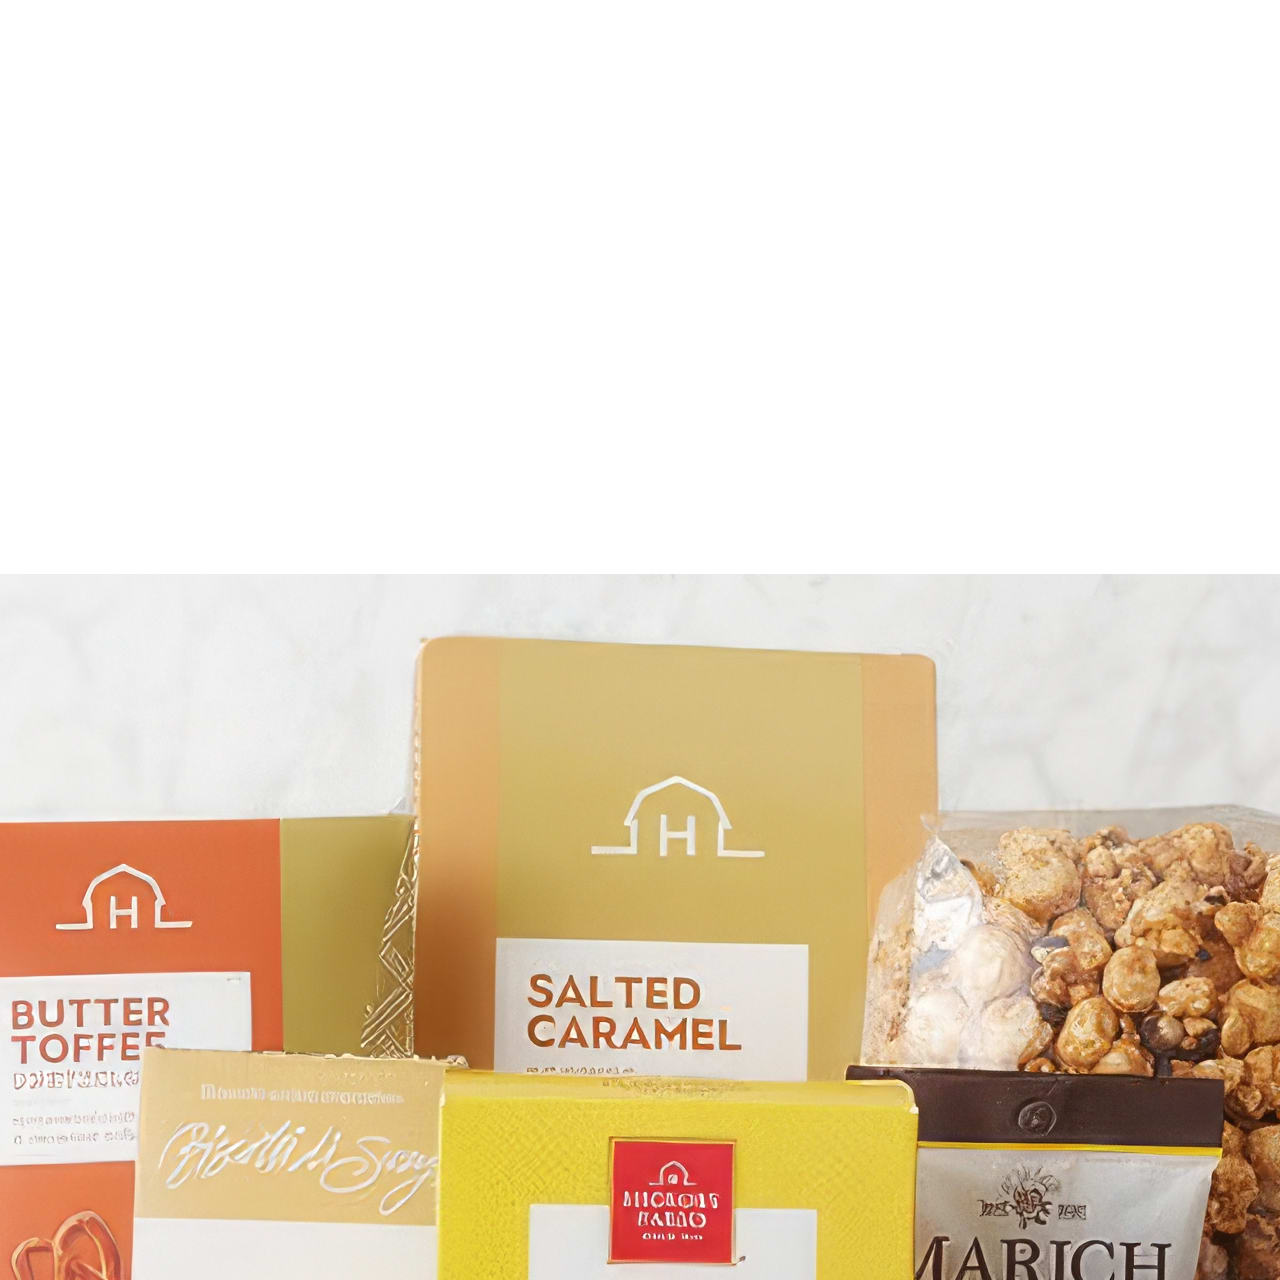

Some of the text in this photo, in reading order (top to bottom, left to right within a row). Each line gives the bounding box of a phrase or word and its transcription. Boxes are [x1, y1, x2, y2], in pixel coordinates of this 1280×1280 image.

[526, 973, 702, 1010] SALTED
[11, 996, 170, 1030] BUTTER
[526, 1013, 743, 1052] CARAMEL
